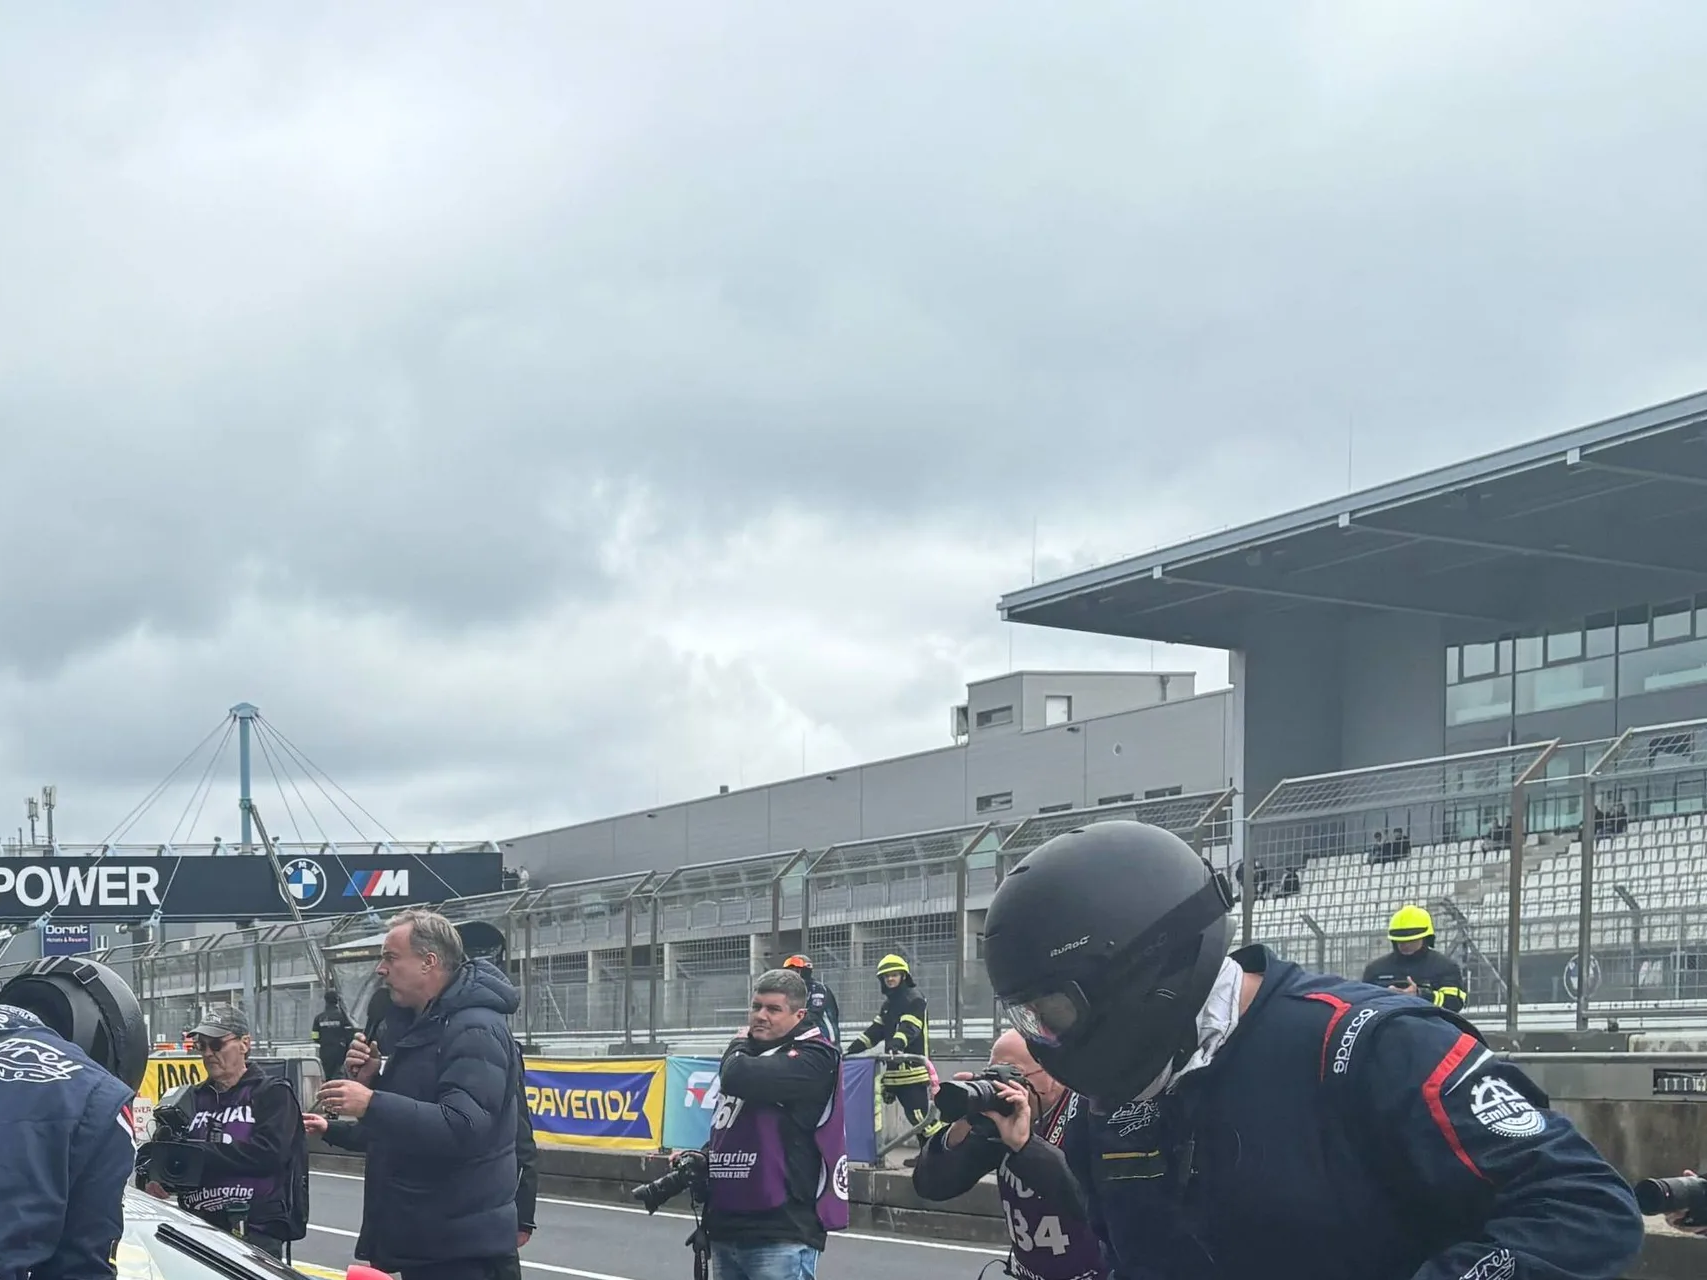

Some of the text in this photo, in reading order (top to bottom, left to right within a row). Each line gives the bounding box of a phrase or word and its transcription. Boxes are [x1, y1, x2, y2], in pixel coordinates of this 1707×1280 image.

[1333, 1008, 1378, 1074] sparco
[525, 1086, 639, 1122] RAVENOL
[1475, 1105, 1512, 1125] Emil
